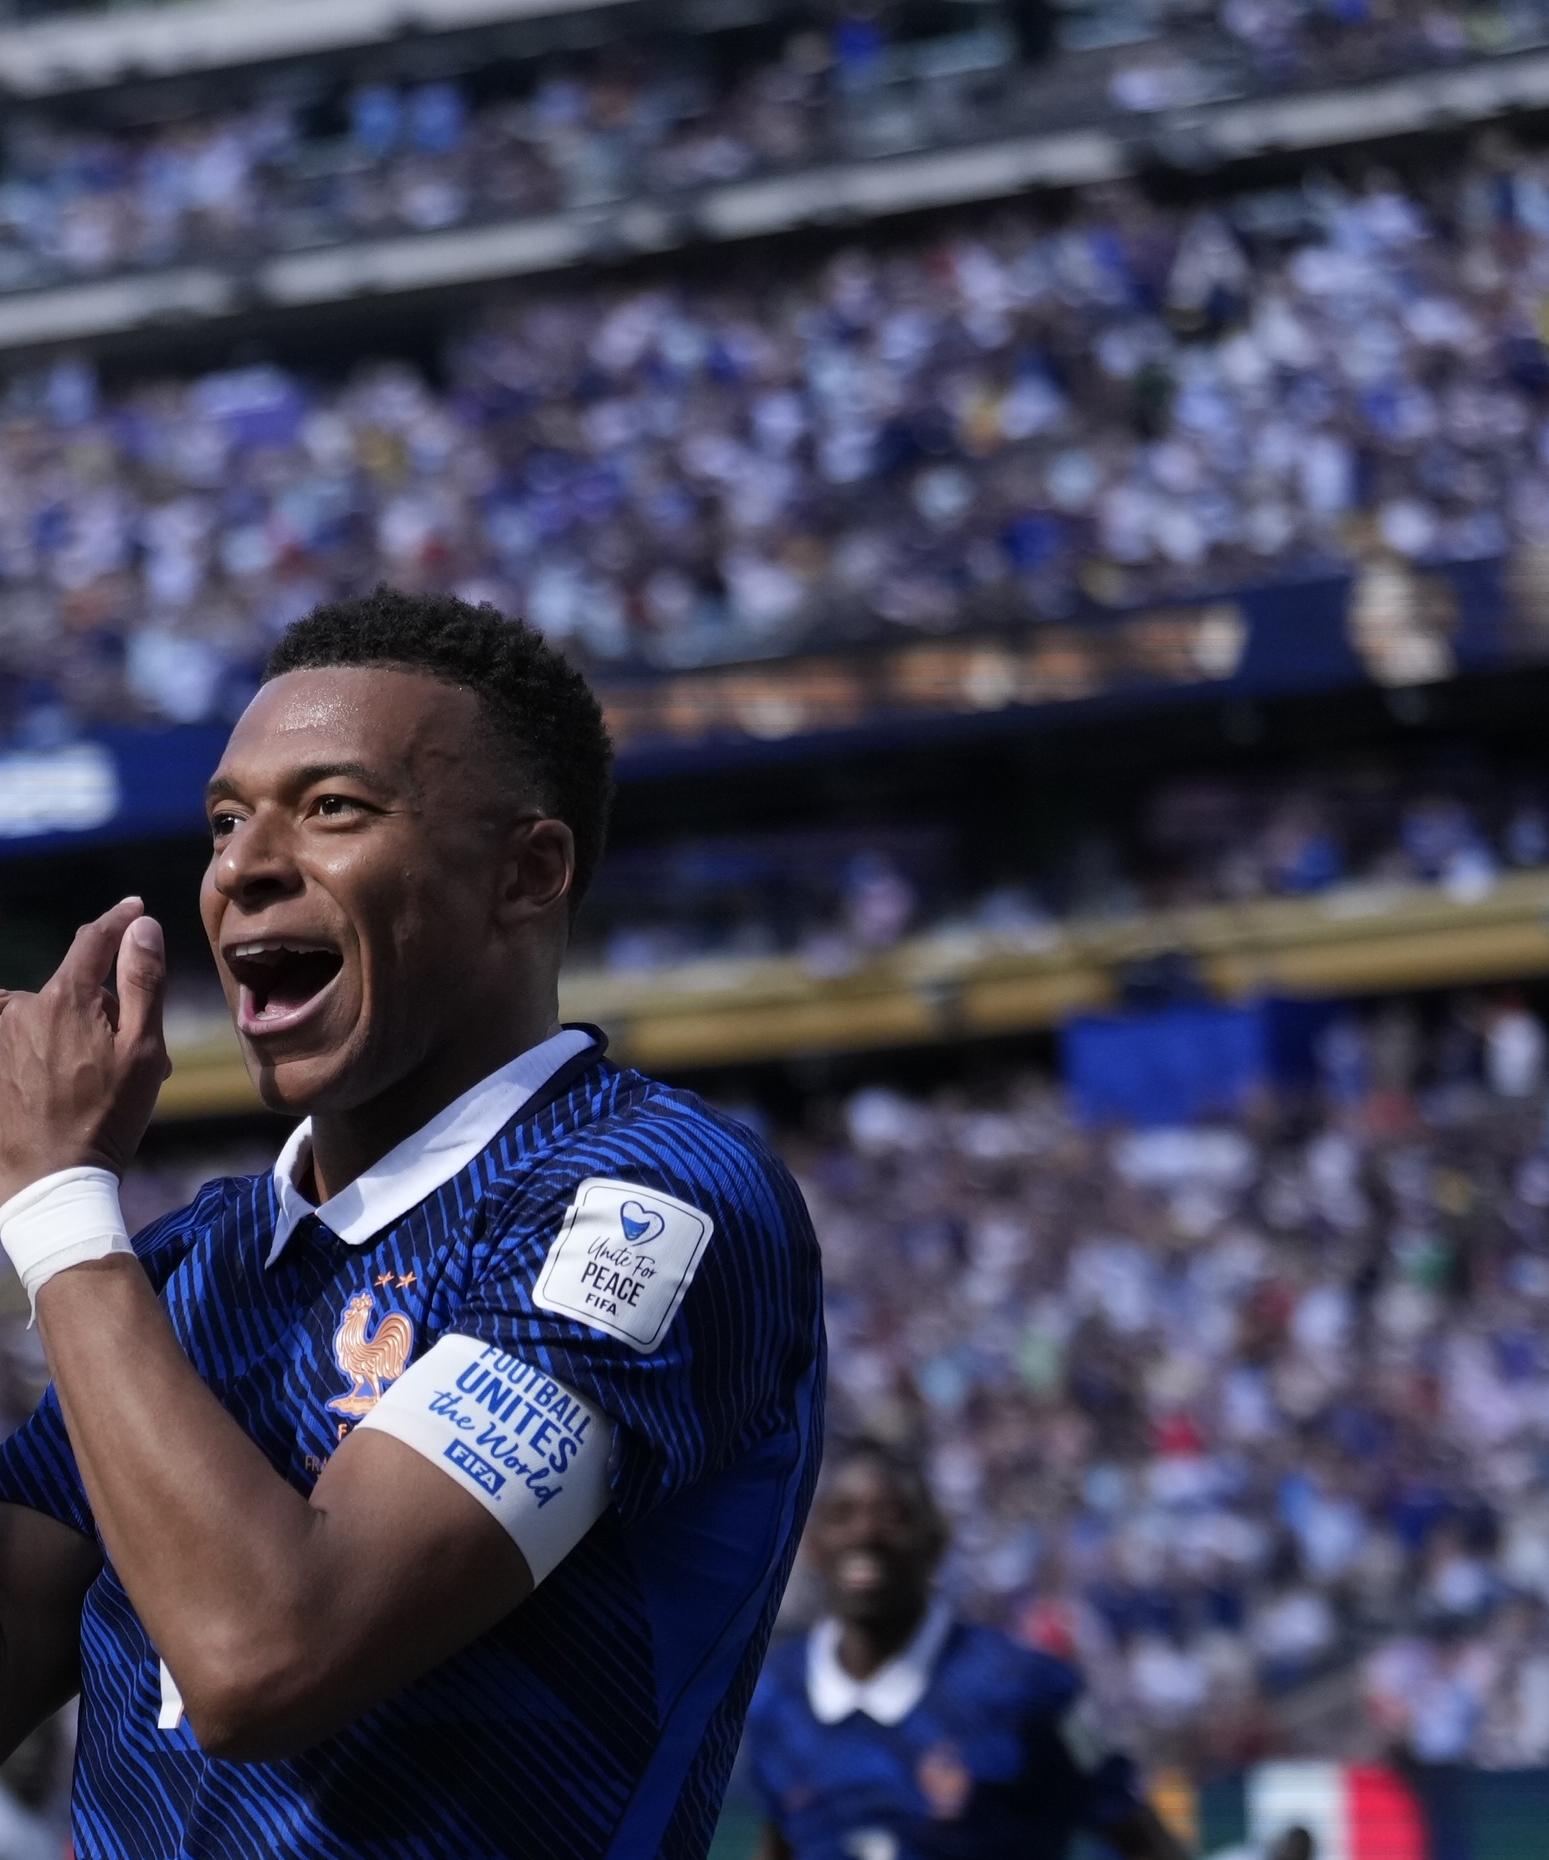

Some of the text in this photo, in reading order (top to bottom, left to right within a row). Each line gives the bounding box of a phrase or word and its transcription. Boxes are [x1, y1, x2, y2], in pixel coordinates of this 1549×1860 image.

[587, 1236, 657, 1279] Unite For
[580, 1261, 645, 1307] PEACE
[585, 1293, 617, 1316] FIFA
[428, 1390, 475, 1430] the
[456, 1361, 577, 1474] UNITES
[479, 1345, 591, 1445] FOOTBALL
[450, 1440, 498, 1490] FIFA
[476, 1421, 563, 1508] World
